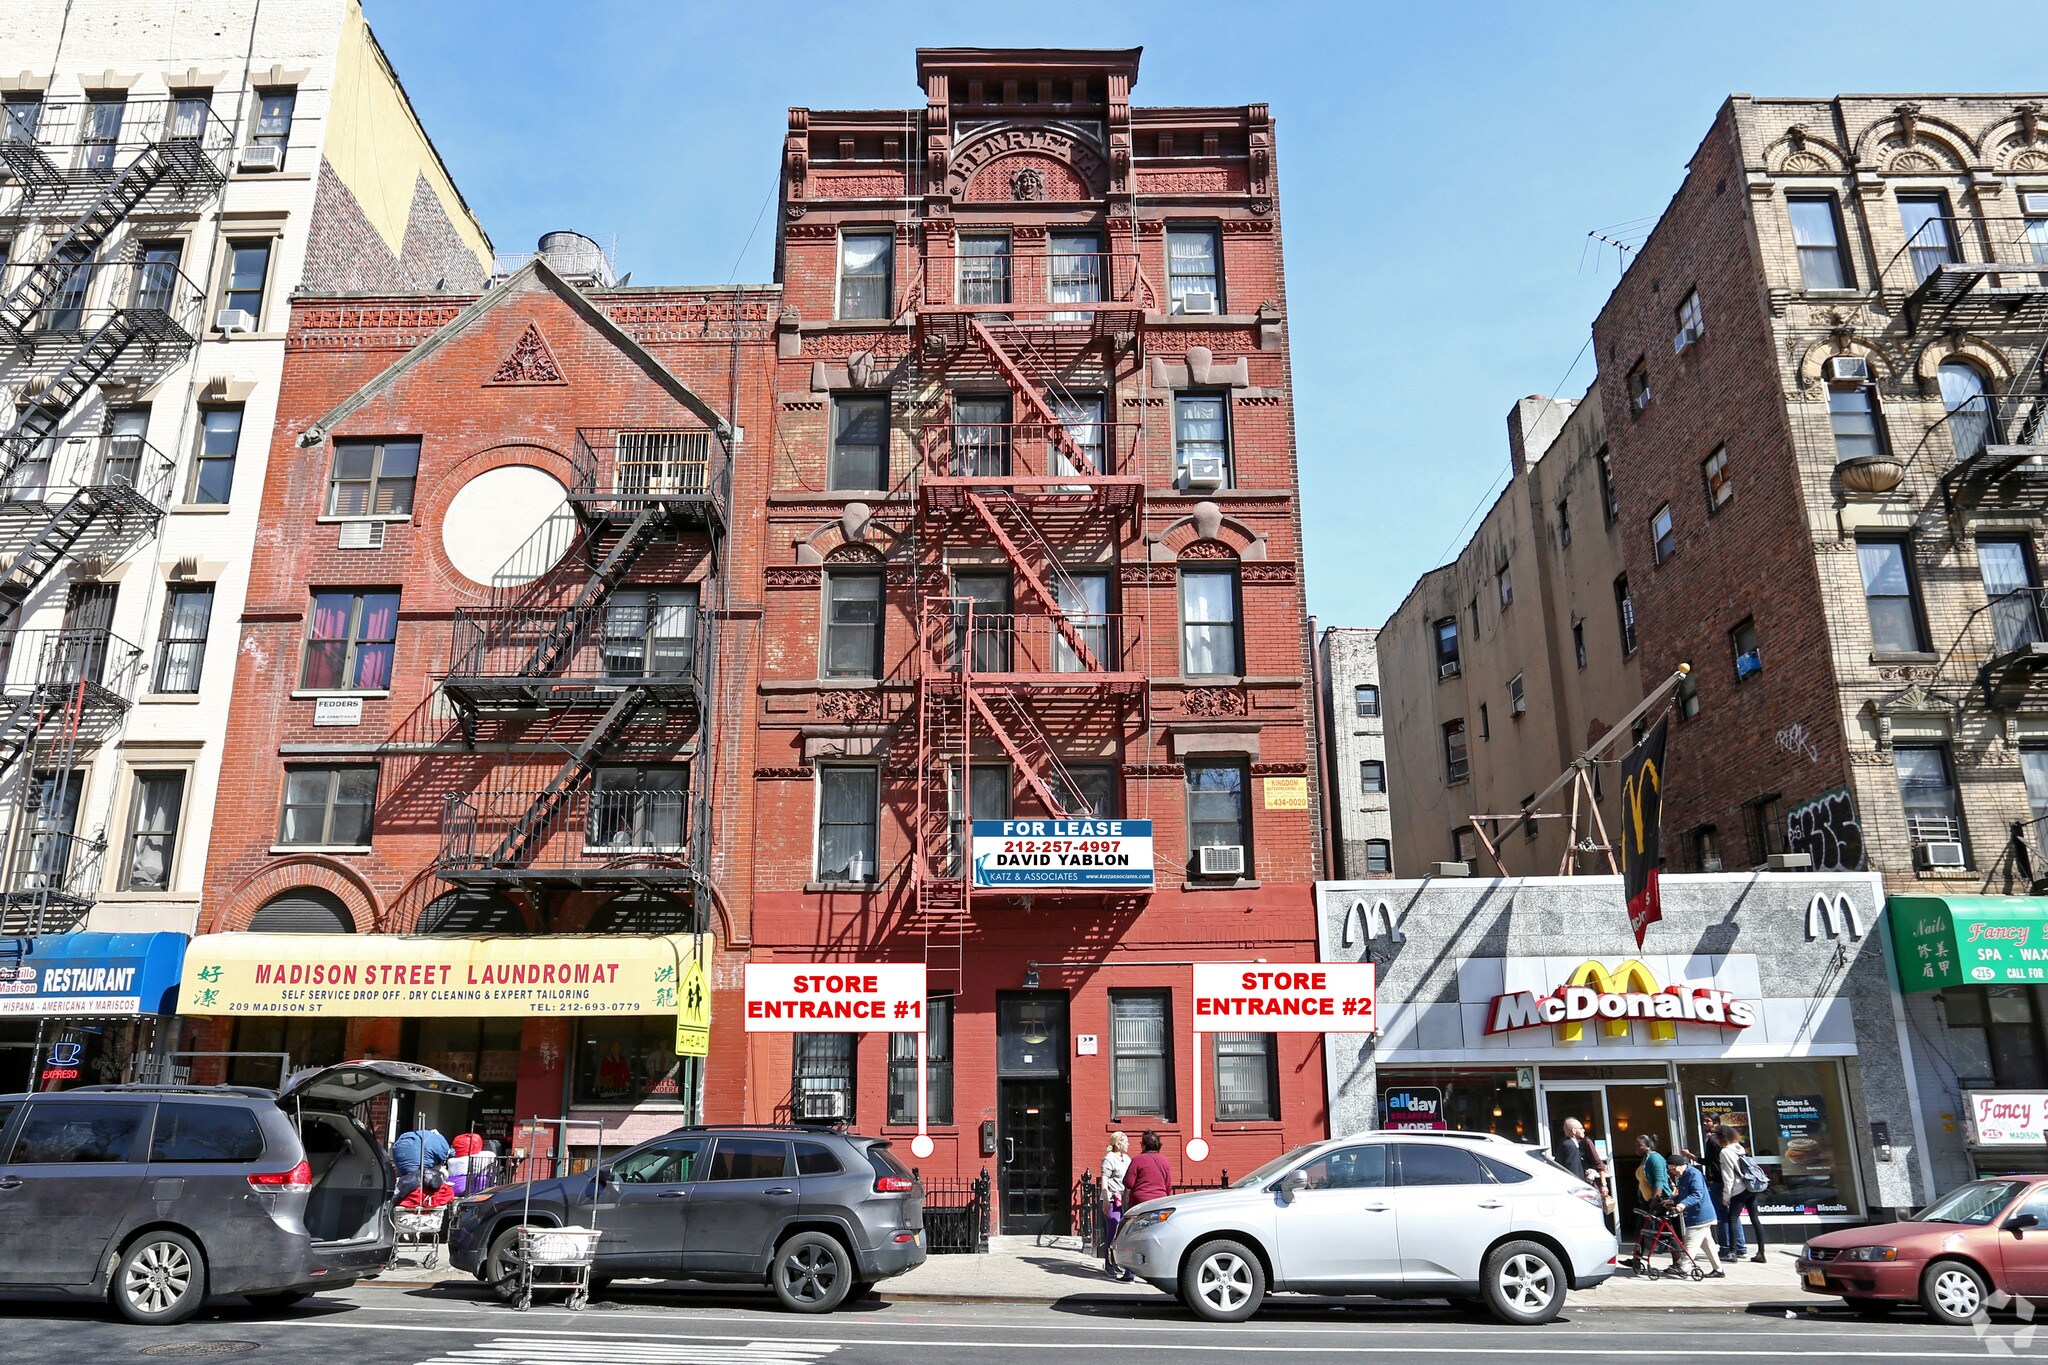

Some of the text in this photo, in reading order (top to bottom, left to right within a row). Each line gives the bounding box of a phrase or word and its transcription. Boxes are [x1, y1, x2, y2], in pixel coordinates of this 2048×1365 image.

[1003, 822, 1122, 835] FOR LEASE
[1004, 841, 1121, 853] 212-257-4997
[997, 854, 1129, 866] DAVID YABLON
[990, 872, 1078, 881] KATZ & ASSOCIATES
[1913, 916, 1946, 938] Nails
[1967, 922, 2030, 946] Fancy
[1977, 948, 2002, 961] SPA
[255, 963, 619, 984] MADISON STREET LAUNDROMAT
[1976, 968, 1992, 978] 215
[2006, 968, 2044, 978] CALL FOR
[43, 968, 136, 992] RESTAURANT
[282, 990, 305, 999] SELF
[308, 990, 350, 999] SERVICE
[353, 990, 379, 1000] DROP
[382, 990, 400, 999] OFF
[409, 990, 428, 1000] DRY
[431, 990, 481, 1000] CLEANING
[484, 991, 490, 999] &
[494, 990, 533, 999] EXPERT
[536, 990, 590, 999] TAILORING
[3, 1002, 35, 1012] HISPANA
[42, 1001, 85, 1011] AMERICANA
[89, 1001, 94, 1010] Y
[95, 1000, 135, 1010] MARISCOS
[229, 1002, 323, 1012] 209 MADISON ST
[530, 1003, 640, 1012] TEL: 212-693-0779
[1494, 986, 1757, 1031] McDonald's
[680, 1035, 706, 1048] AHEAD
[43, 1070, 78, 1079] EXPRESO
[1521, 1071, 1531, 1082] A
[1980, 1098, 2030, 1128] Fancy
